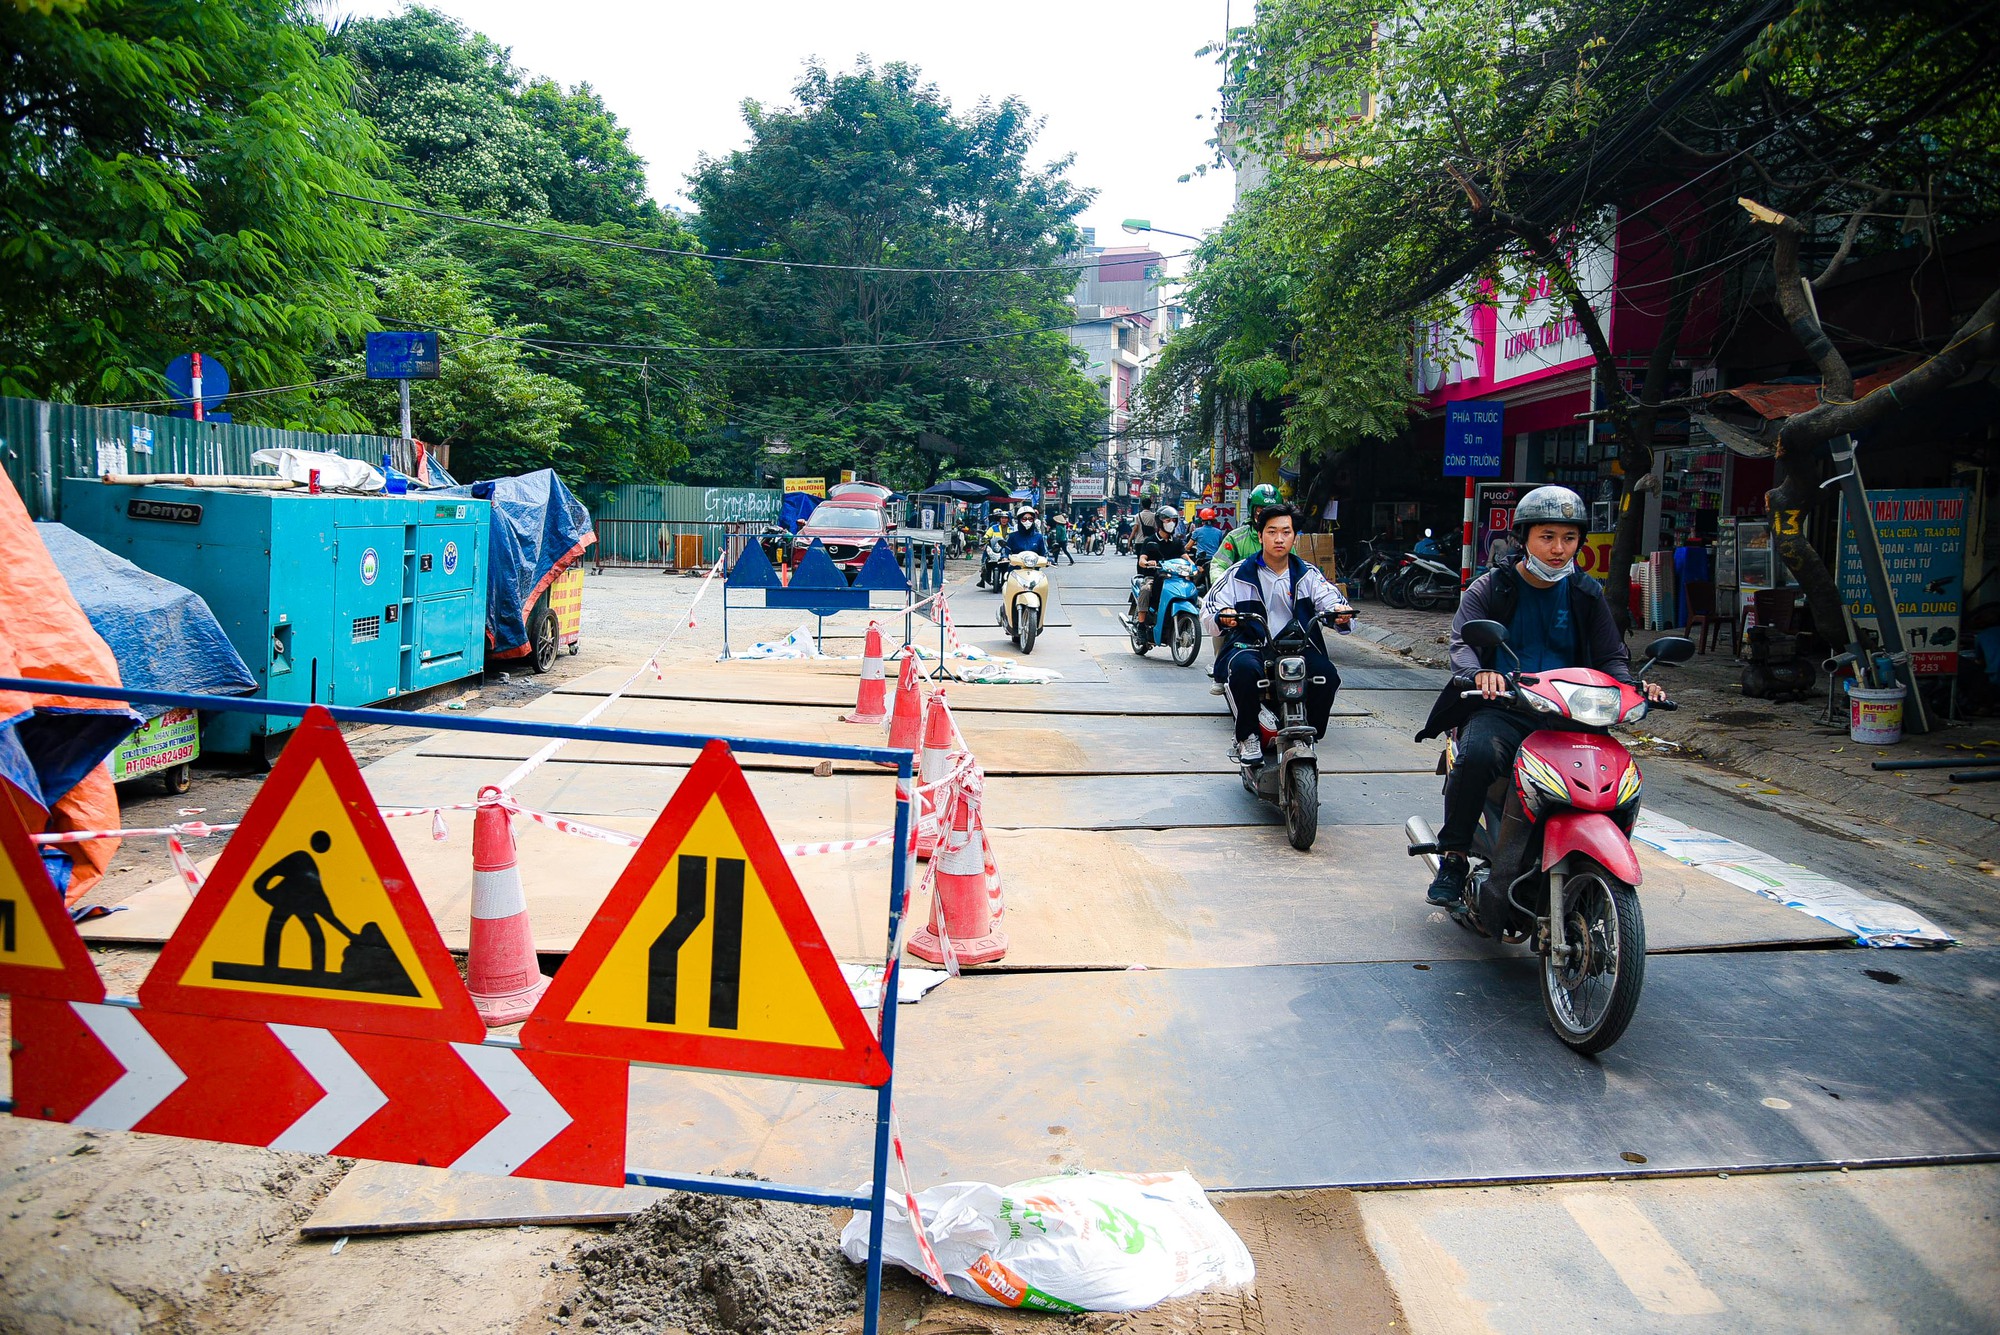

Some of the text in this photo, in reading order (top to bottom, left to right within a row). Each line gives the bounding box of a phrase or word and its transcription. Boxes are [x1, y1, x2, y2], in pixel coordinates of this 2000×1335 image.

[1452, 409, 1498, 423] PHÍA TRƯỚC
[1463, 433, 1483, 444] 50 m
[1445, 453, 1500, 467] CÔNG TRƯỜNG
[1483, 491, 1509, 500] PUGO
[136, 502, 193, 519] Denyo
[1875, 496, 1900, 522] MÁY
[1903, 495, 1934, 522] XUÂN
[1774, 509, 1800, 536] 13
[1924, 528, 1945, 538] TRAO
[1879, 543, 1904, 555] HOAN
[1905, 573, 1923, 583] PIN
[1896, 602, 1917, 613] GIA
[1921, 602, 1957, 615] DỤNG
[1921, 663, 1939, 672] 253
